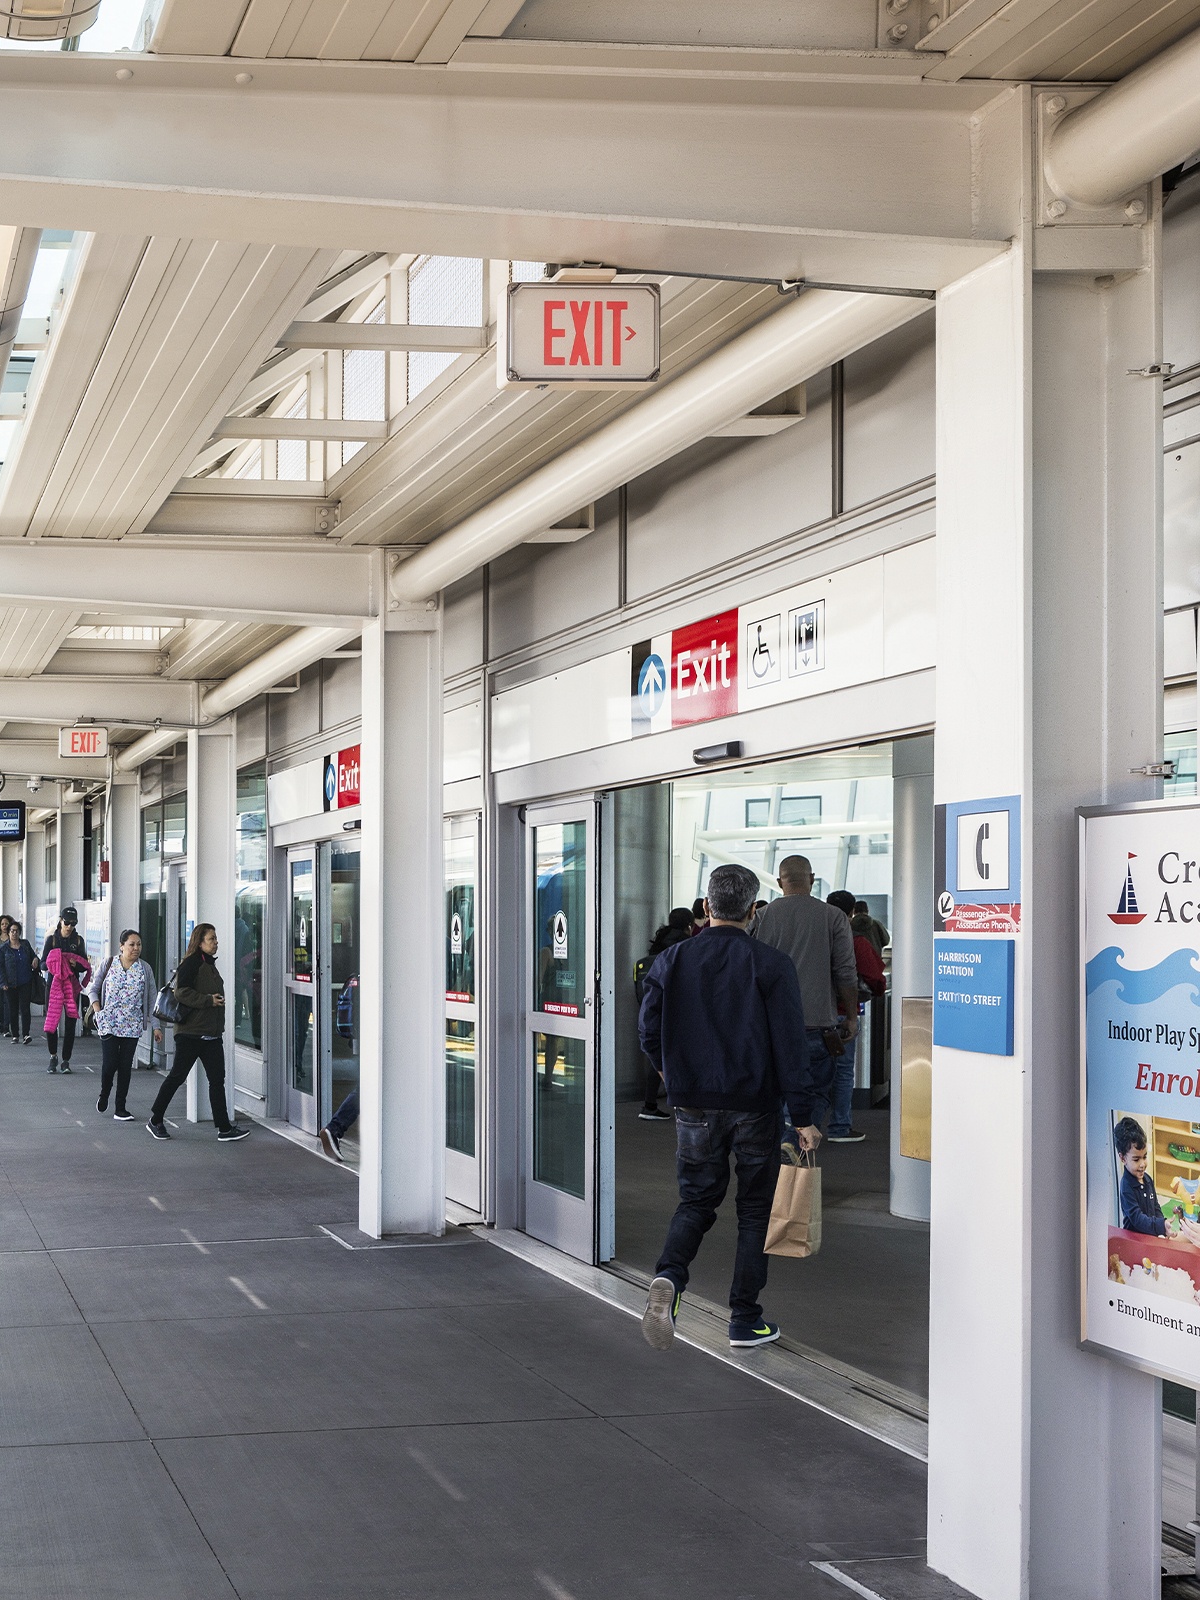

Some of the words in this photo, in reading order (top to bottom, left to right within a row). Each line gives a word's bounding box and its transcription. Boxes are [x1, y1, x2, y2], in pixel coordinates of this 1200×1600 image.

[543, 300, 628, 366] EXIT
[677, 639, 731, 700] Exit
[71, 731, 99, 753] EXIT
[339, 759, 359, 793] Exit
[1157, 851, 1200, 885] Cr
[961, 994, 971, 1004] TO
[973, 995, 1002, 1007] STREET
[1108, 1020, 1152, 1042] Indoor
[1156, 1024, 1186, 1052] Play
[1117, 1299, 1183, 1332] Enrollment
